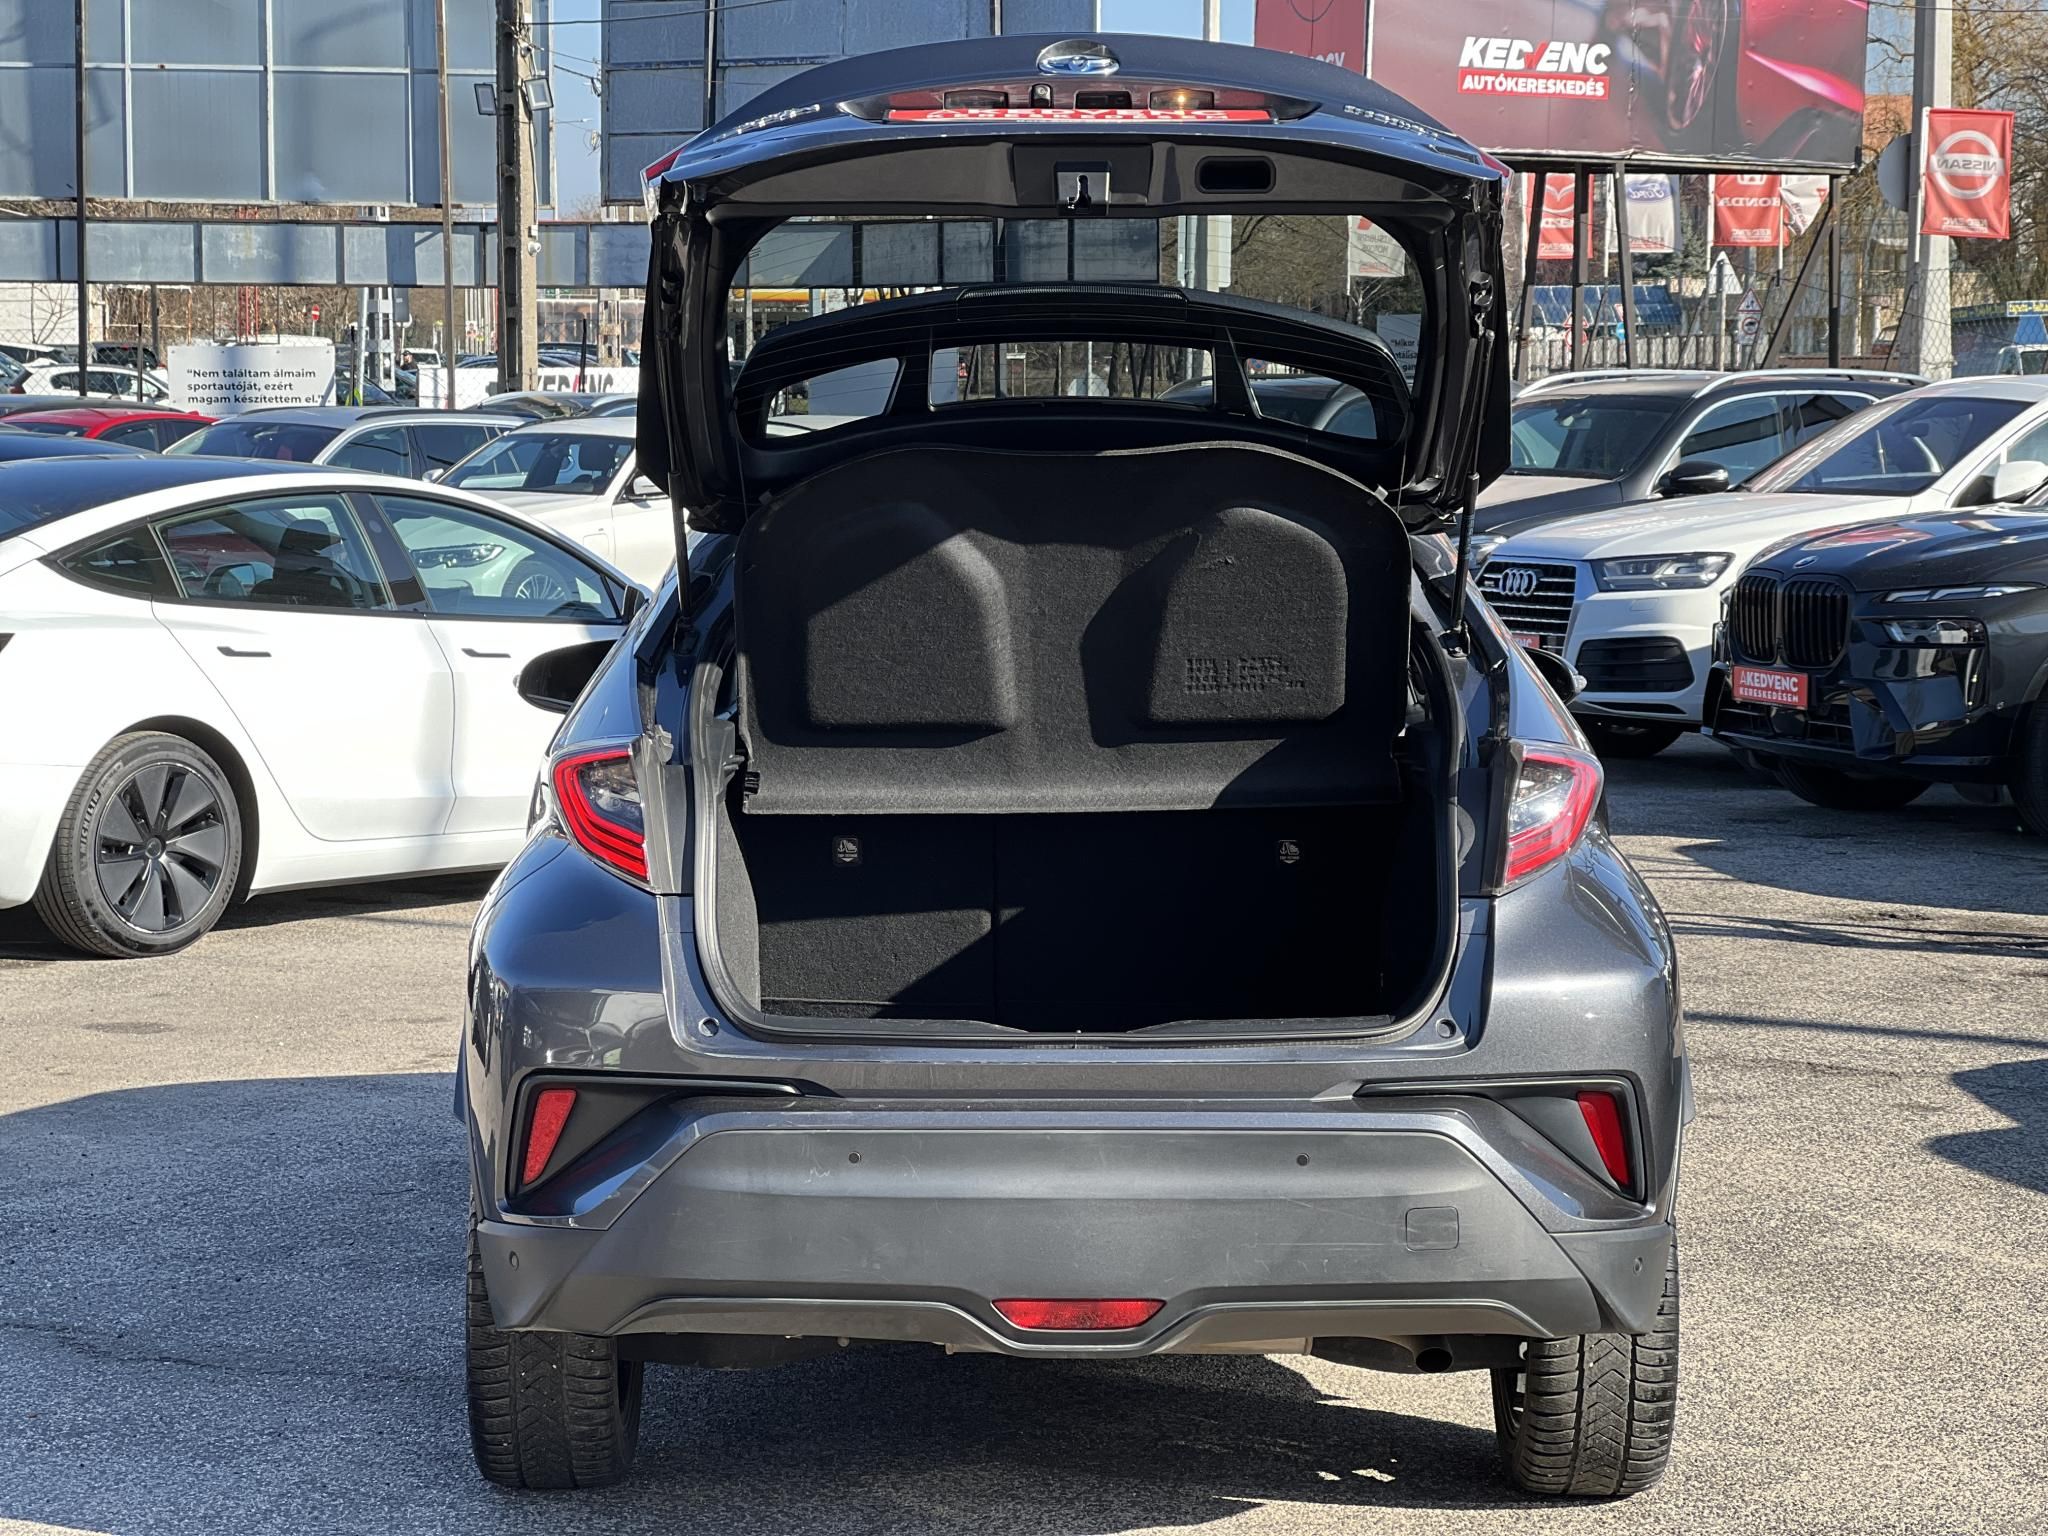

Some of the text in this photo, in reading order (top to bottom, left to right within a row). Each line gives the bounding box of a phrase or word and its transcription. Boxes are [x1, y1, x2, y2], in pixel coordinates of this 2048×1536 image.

[1459, 36, 1611, 75] KEDVENC
[1462, 73, 1605, 97] AUTÓKERESKEDÉS
[222, 368, 271, 378] találtam
[273, 368, 316, 378] álmaim
[187, 381, 294, 393] sportautóját, ezért
[188, 395, 230, 405] magam
[234, 393, 301, 404] készítettem
